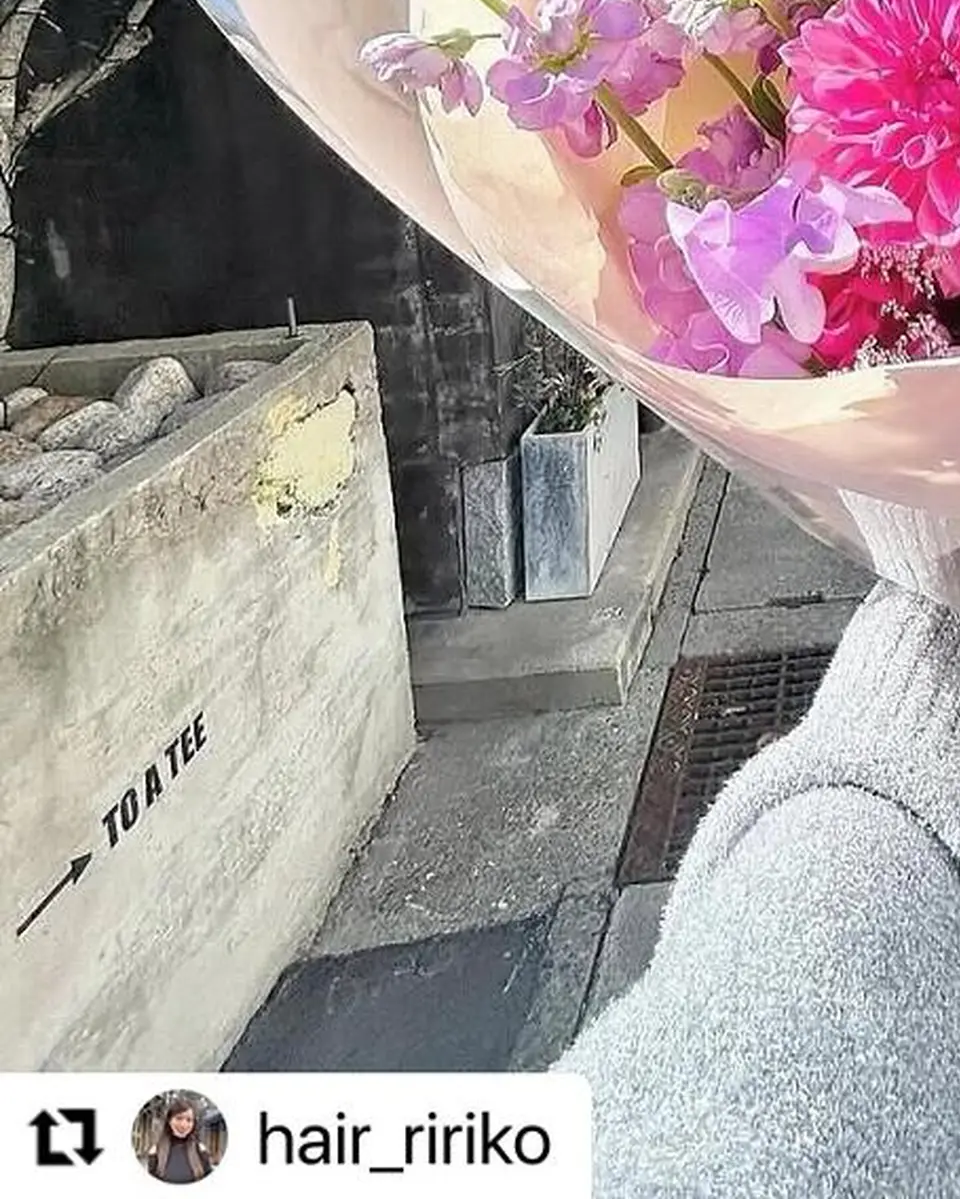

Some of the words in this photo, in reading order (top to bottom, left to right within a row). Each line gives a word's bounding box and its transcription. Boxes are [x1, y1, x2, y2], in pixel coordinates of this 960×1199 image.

[102, 788, 138, 848] TO
[145, 763, 163, 808] A
[165, 711, 206, 779] TEE
